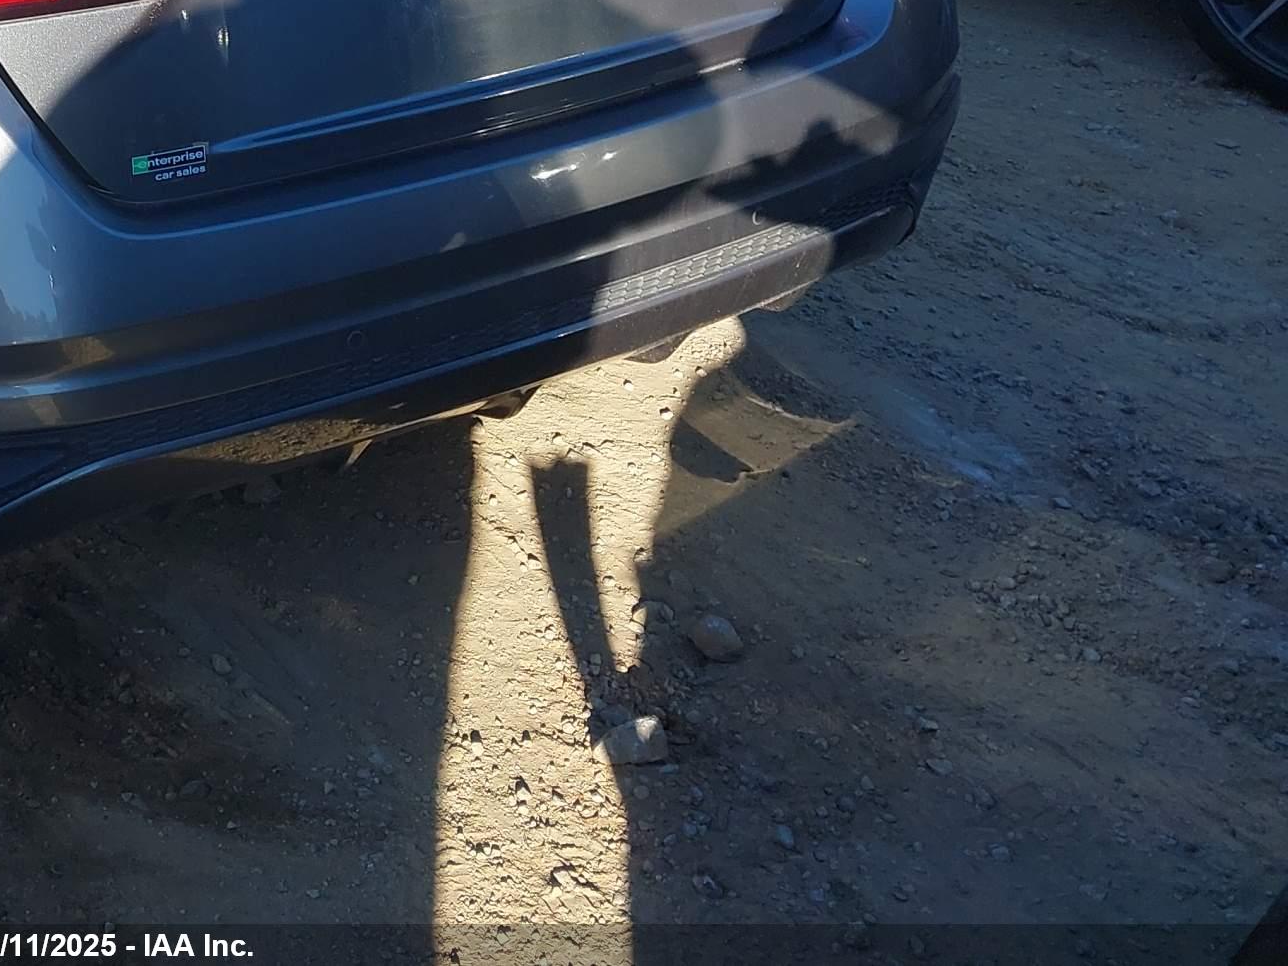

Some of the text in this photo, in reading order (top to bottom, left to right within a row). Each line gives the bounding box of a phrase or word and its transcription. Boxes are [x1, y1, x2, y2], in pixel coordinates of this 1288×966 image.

[134, 150, 204, 169] enterprise
[155, 165, 206, 181] car sales
